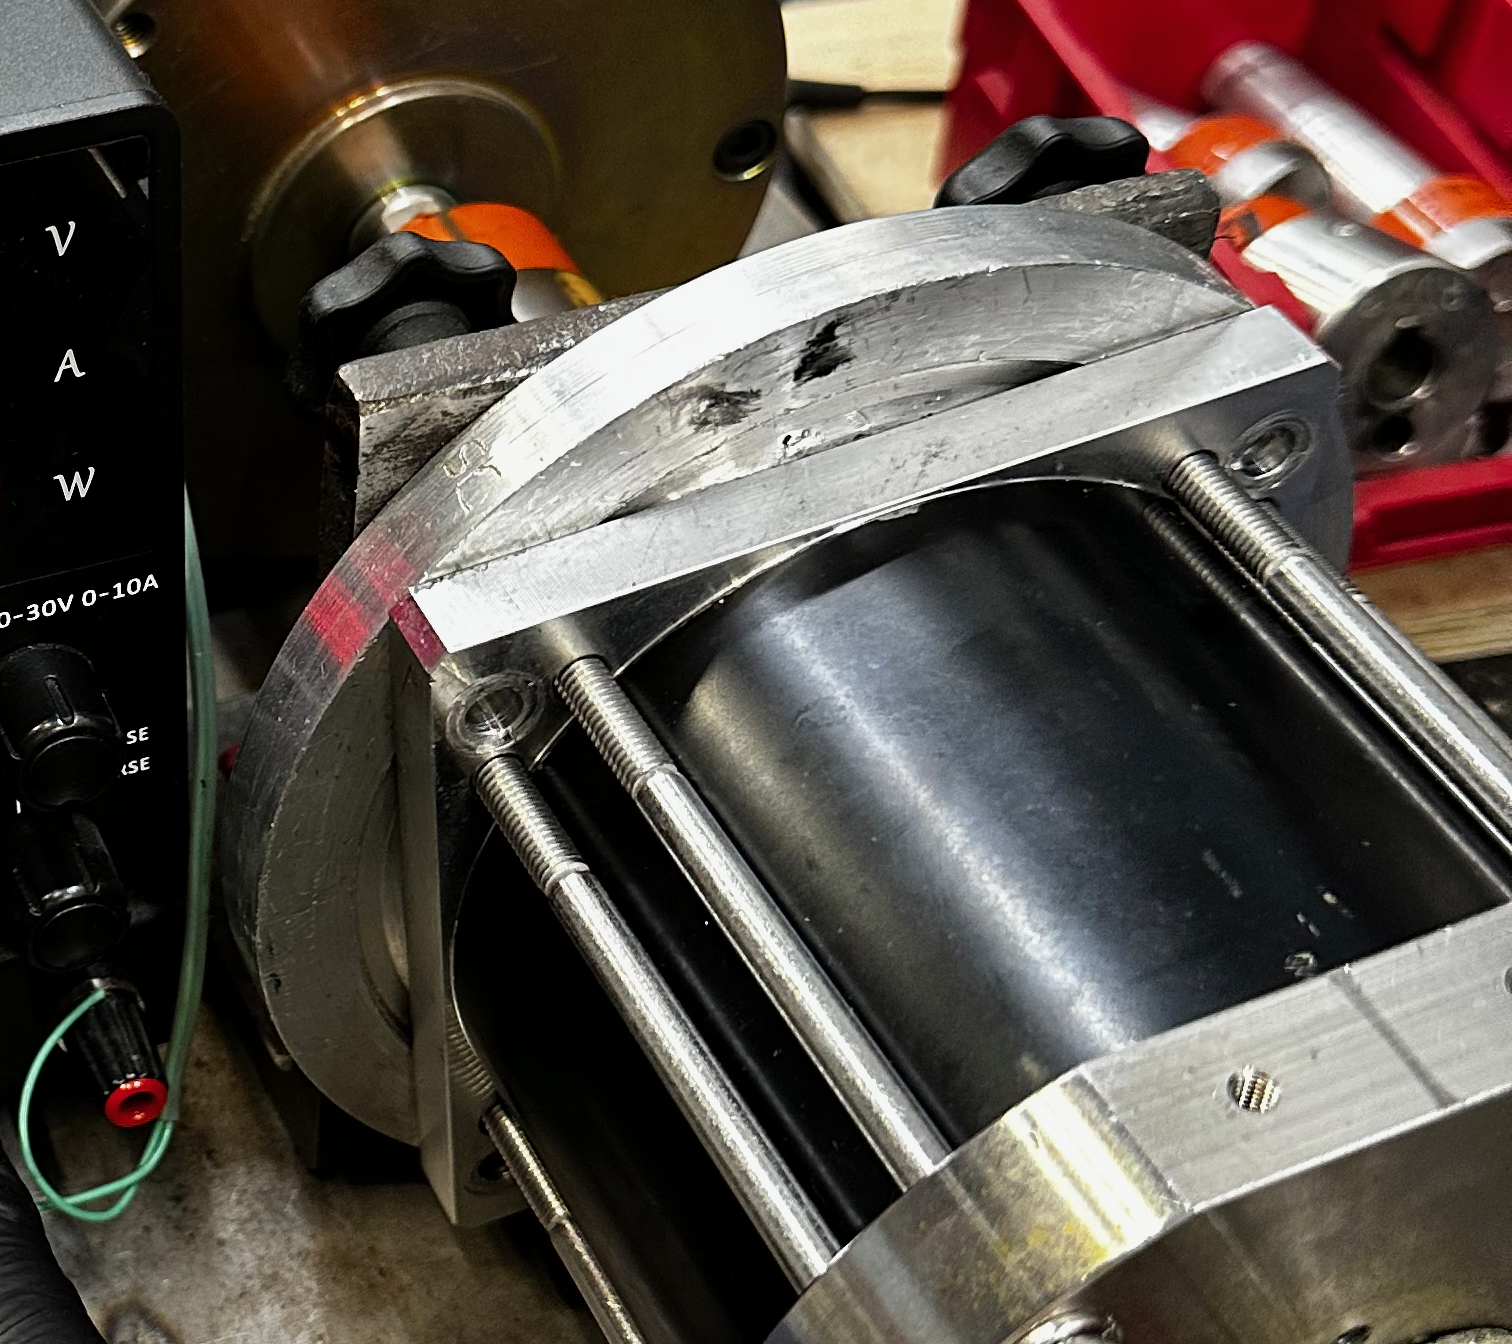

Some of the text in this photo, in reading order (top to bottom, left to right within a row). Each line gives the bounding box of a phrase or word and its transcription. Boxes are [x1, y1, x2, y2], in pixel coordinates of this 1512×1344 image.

[53, 348, 86, 382] A
[53, 466, 95, 501] W
[81, 573, 159, 608] 0-10A
